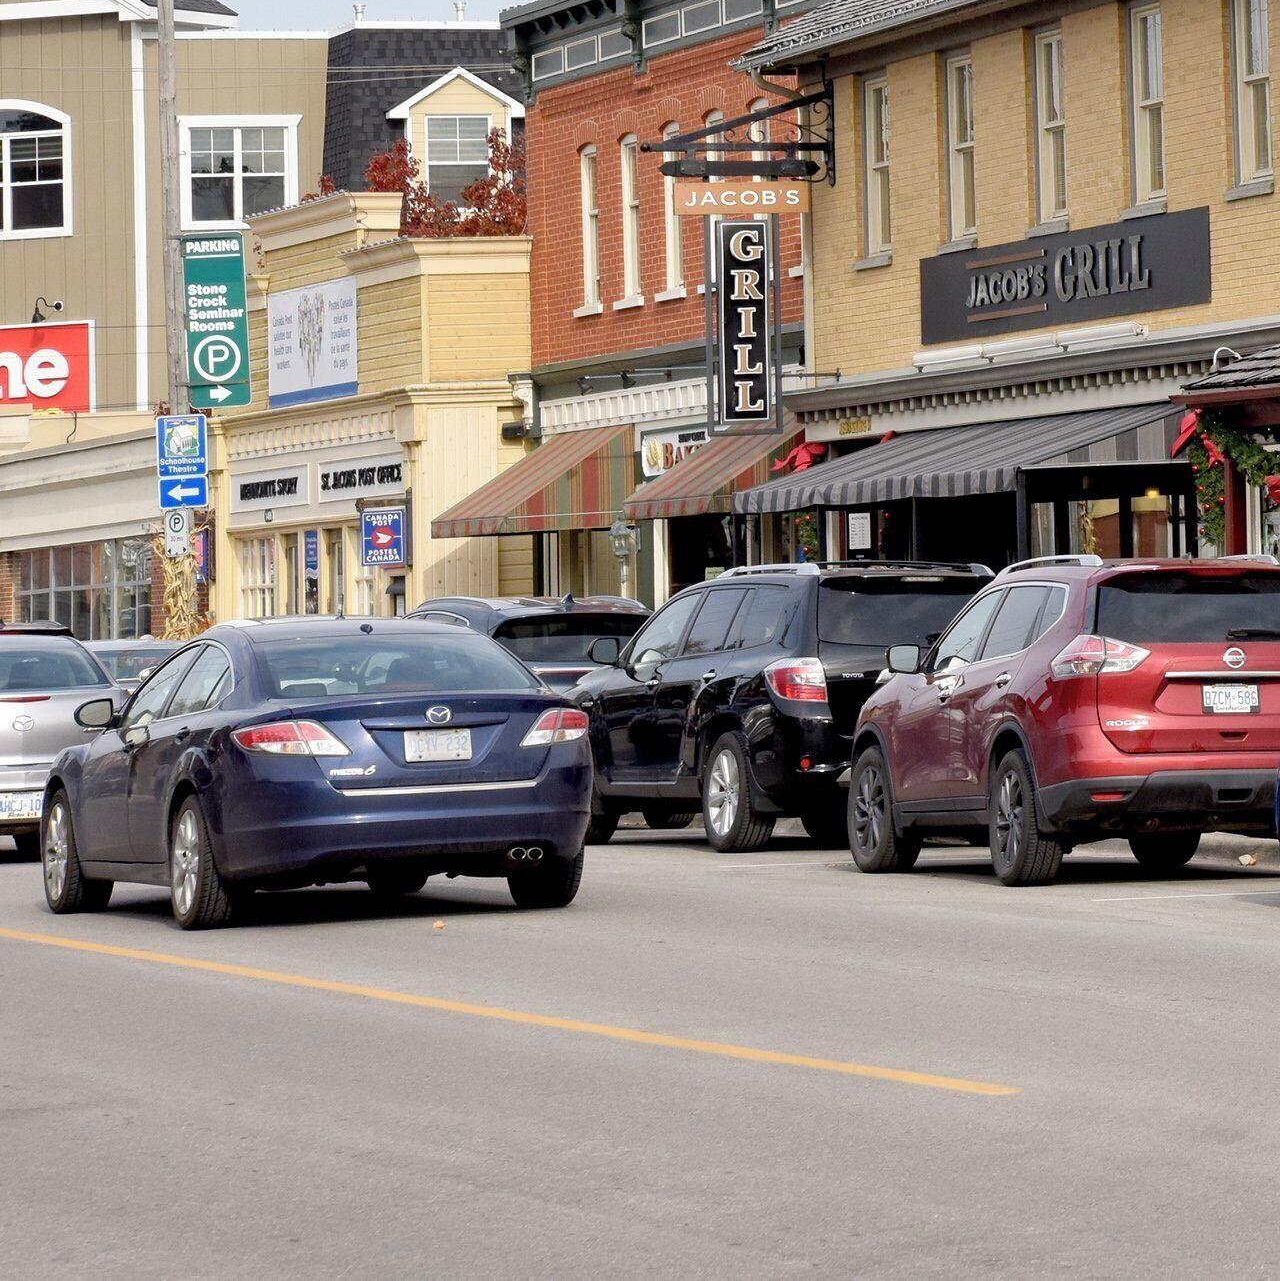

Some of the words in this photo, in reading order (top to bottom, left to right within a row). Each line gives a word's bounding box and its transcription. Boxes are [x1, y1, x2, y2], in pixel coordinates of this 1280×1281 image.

[685, 189, 800, 207] JACOB'S
[185, 240, 240, 253] PARKING
[966, 264, 1046, 308] JACOB'S
[1054, 234, 1150, 303] GRILL
[188, 284, 227, 296] Stone
[188, 296, 227, 308] Crock
[189, 307, 244, 320] Seminar
[190, 320, 235, 332] Rooms
[729, 230, 764, 412] GRILL
[160, 457, 205, 466] Schoolhouse
[168, 465, 198, 473] Theatre
[358, 467, 376, 486] POST
[365, 513, 399, 521] CANADA
[366, 554, 400, 562] CANADA
[1106, 719, 1149, 727] ROGUE
